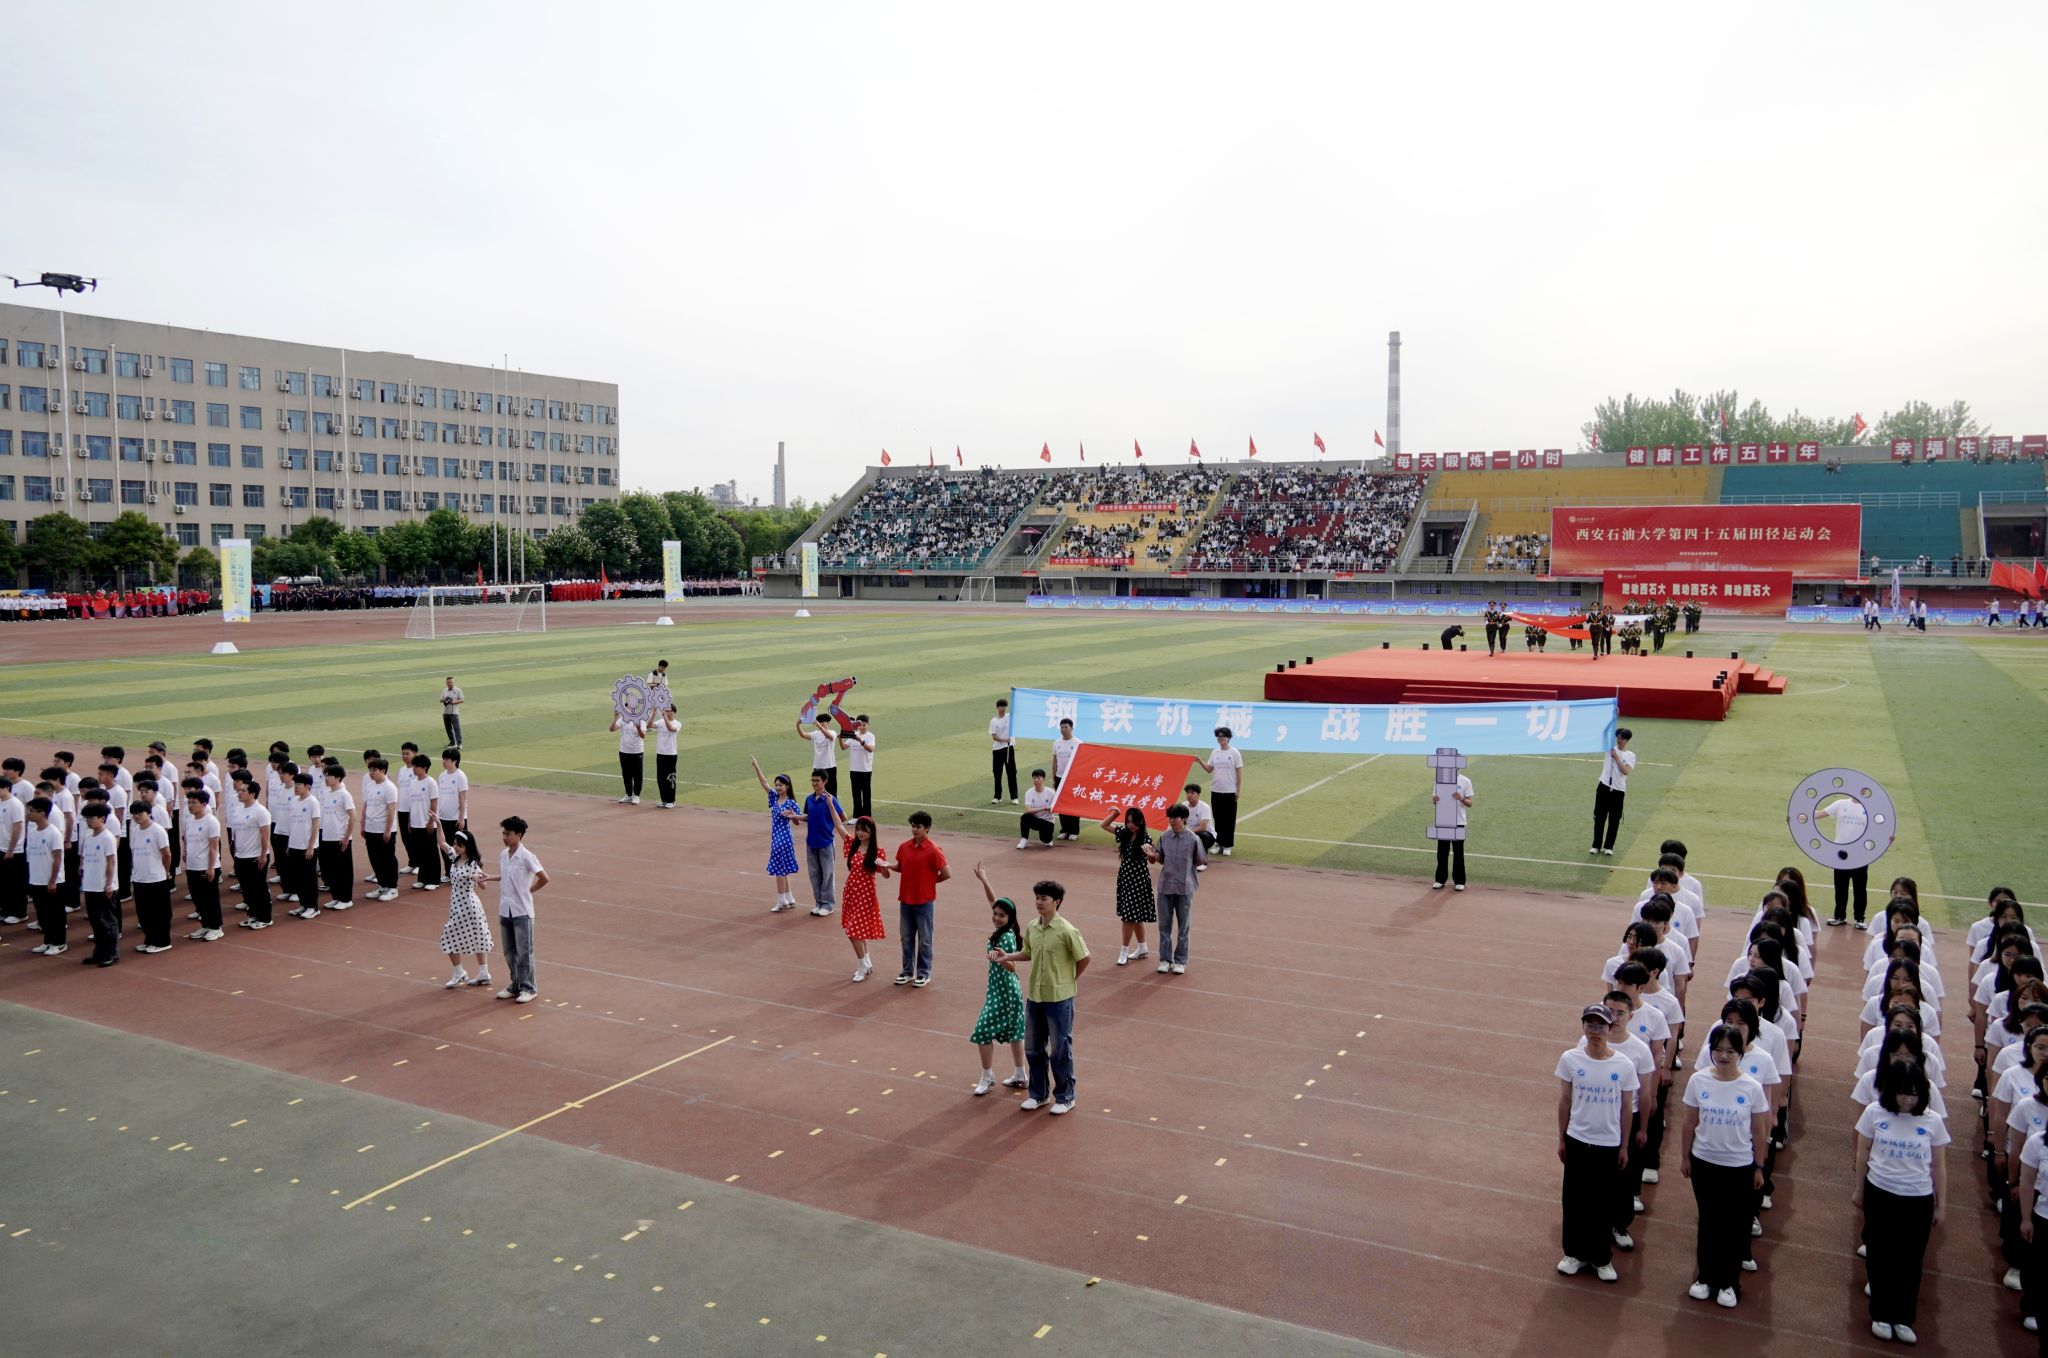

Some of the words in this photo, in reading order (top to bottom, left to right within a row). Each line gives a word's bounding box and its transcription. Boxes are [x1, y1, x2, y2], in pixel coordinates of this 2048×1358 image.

[1397, 451, 1561, 469] 每天锻炼一小时
[1629, 444, 1816, 464] 健康工作五十年
[1576, 526, 1832, 541] 西安石油大学第四十五届田径运动会
[1092, 766, 1164, 790] 西安石油大学
[1072, 784, 1167, 810] 机械工程学院
